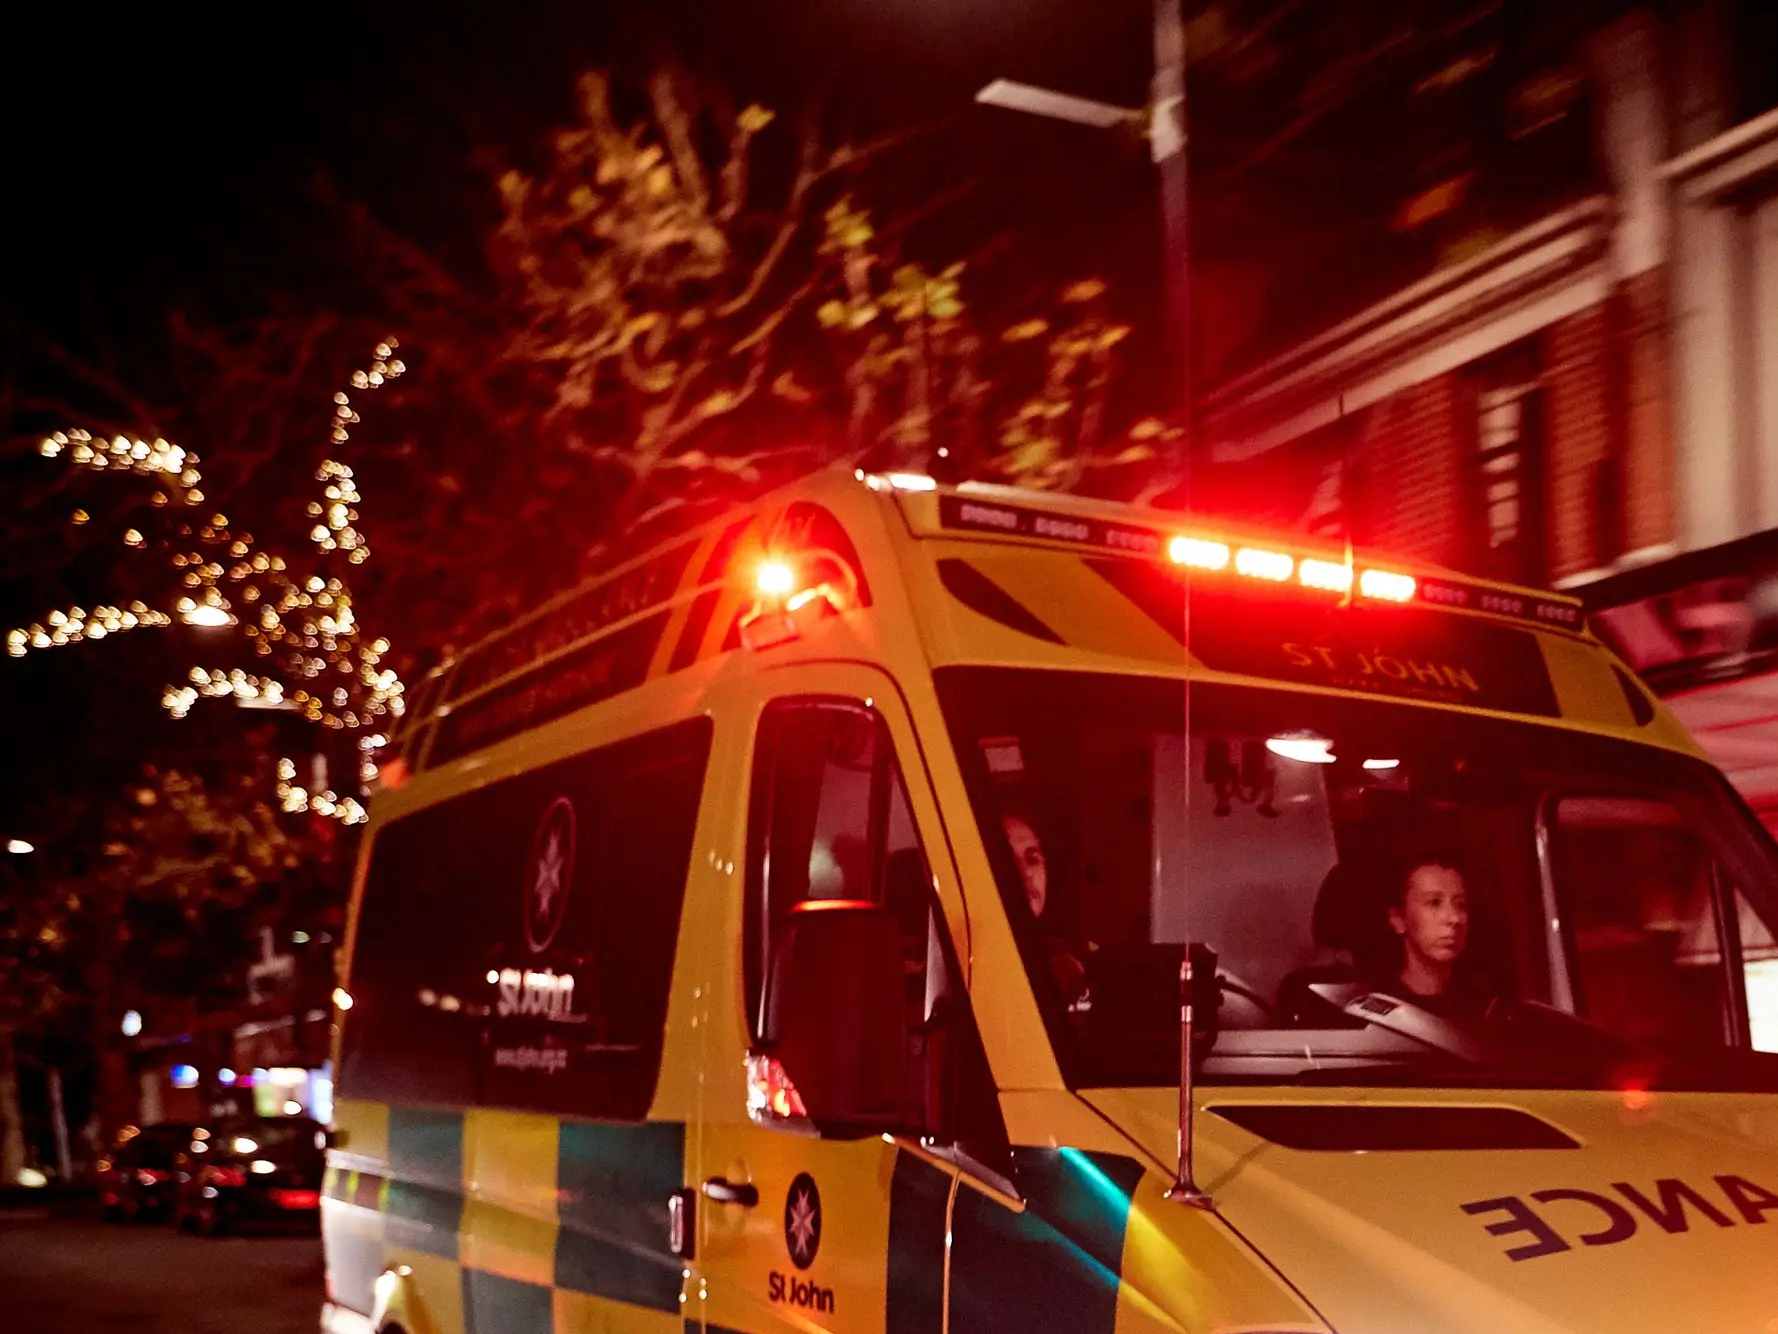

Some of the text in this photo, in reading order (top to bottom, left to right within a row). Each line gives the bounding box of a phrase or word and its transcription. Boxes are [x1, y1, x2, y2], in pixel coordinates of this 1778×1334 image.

[1280, 641, 1335, 669] ST
[1357, 651, 1480, 692] JOHN
[768, 1271, 834, 1314] St John
